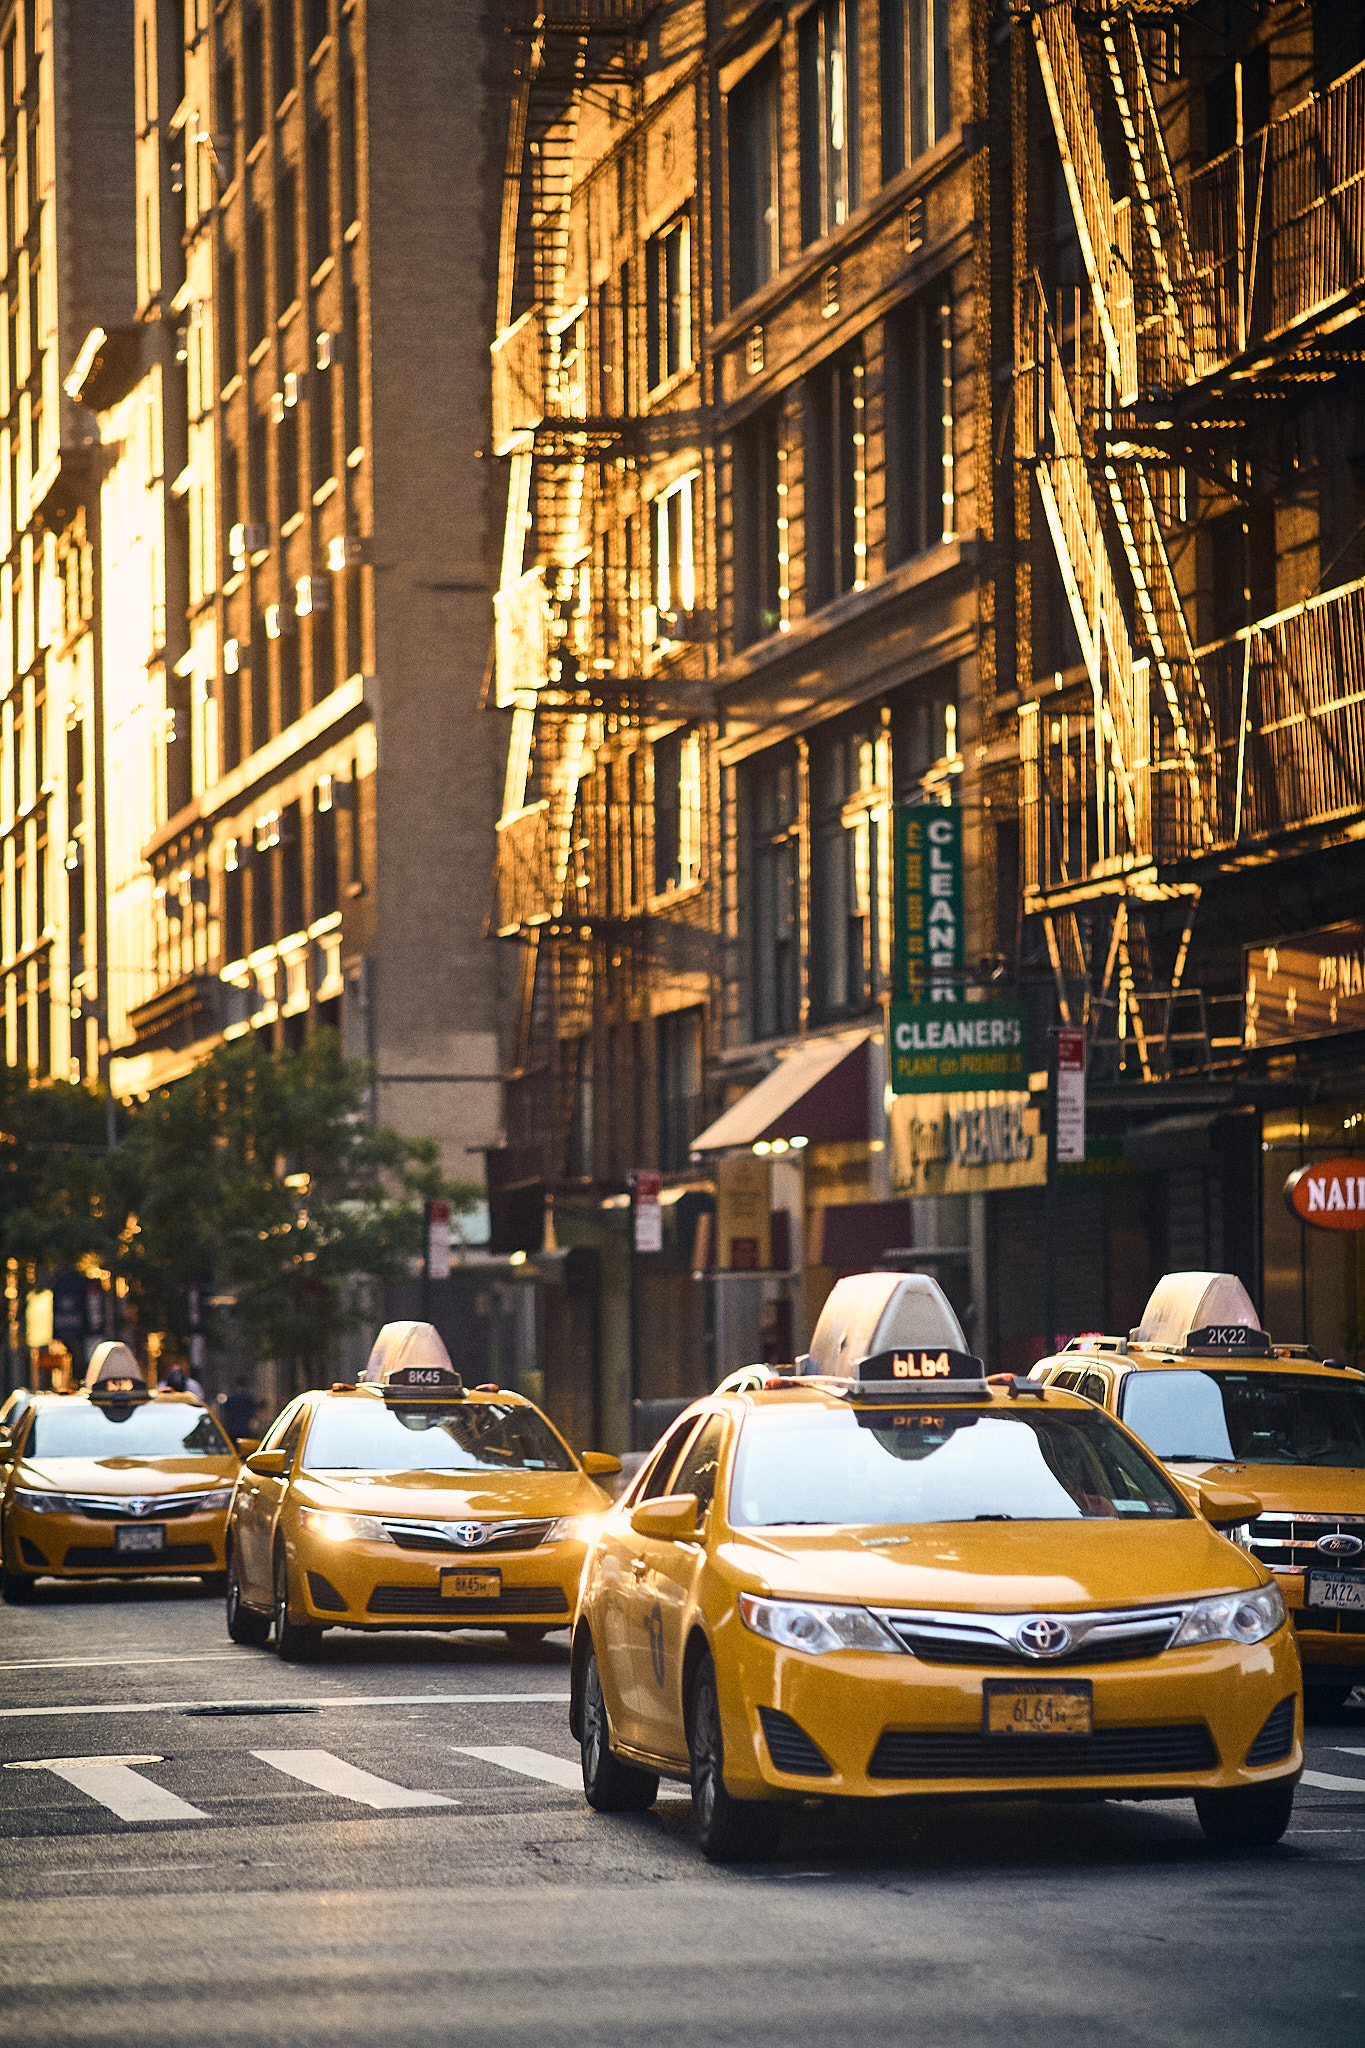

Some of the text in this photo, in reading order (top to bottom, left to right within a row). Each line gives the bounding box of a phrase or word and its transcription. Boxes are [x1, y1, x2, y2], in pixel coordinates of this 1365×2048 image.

[896, 1018, 1021, 1050] CLEANERS
[1208, 1328, 1246, 1345] 2K22
[409, 1370, 441, 1384] 8K45
